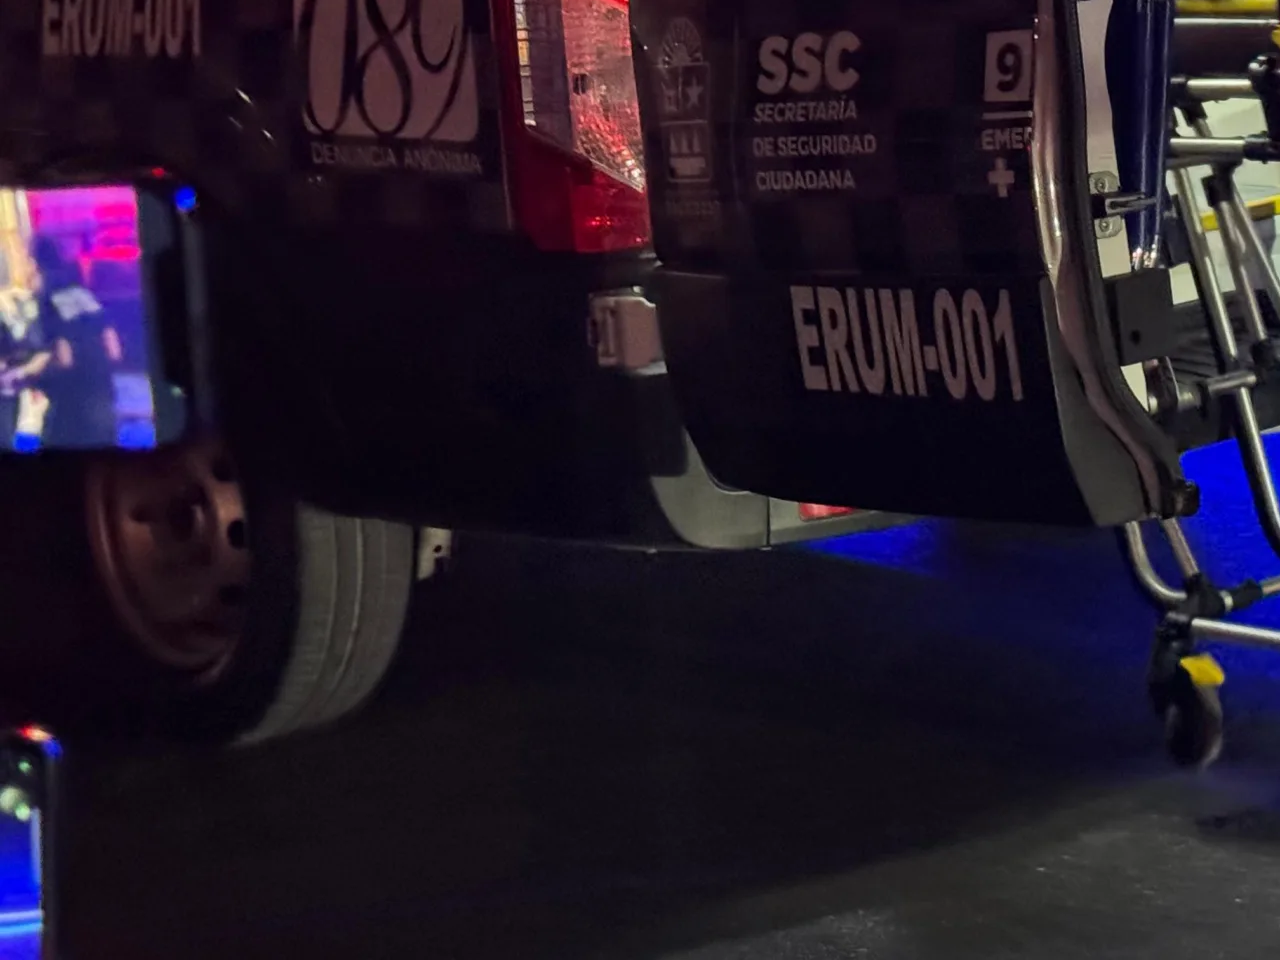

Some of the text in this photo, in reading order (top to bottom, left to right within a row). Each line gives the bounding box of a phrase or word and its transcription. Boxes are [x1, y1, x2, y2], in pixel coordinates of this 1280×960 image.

[756, 30, 861, 95] SSC
[752, 133, 877, 157] DE SEGURIDAD
[756, 169, 855, 191] CIUDADANA
[790, 284, 1024, 402] ERUM-001
